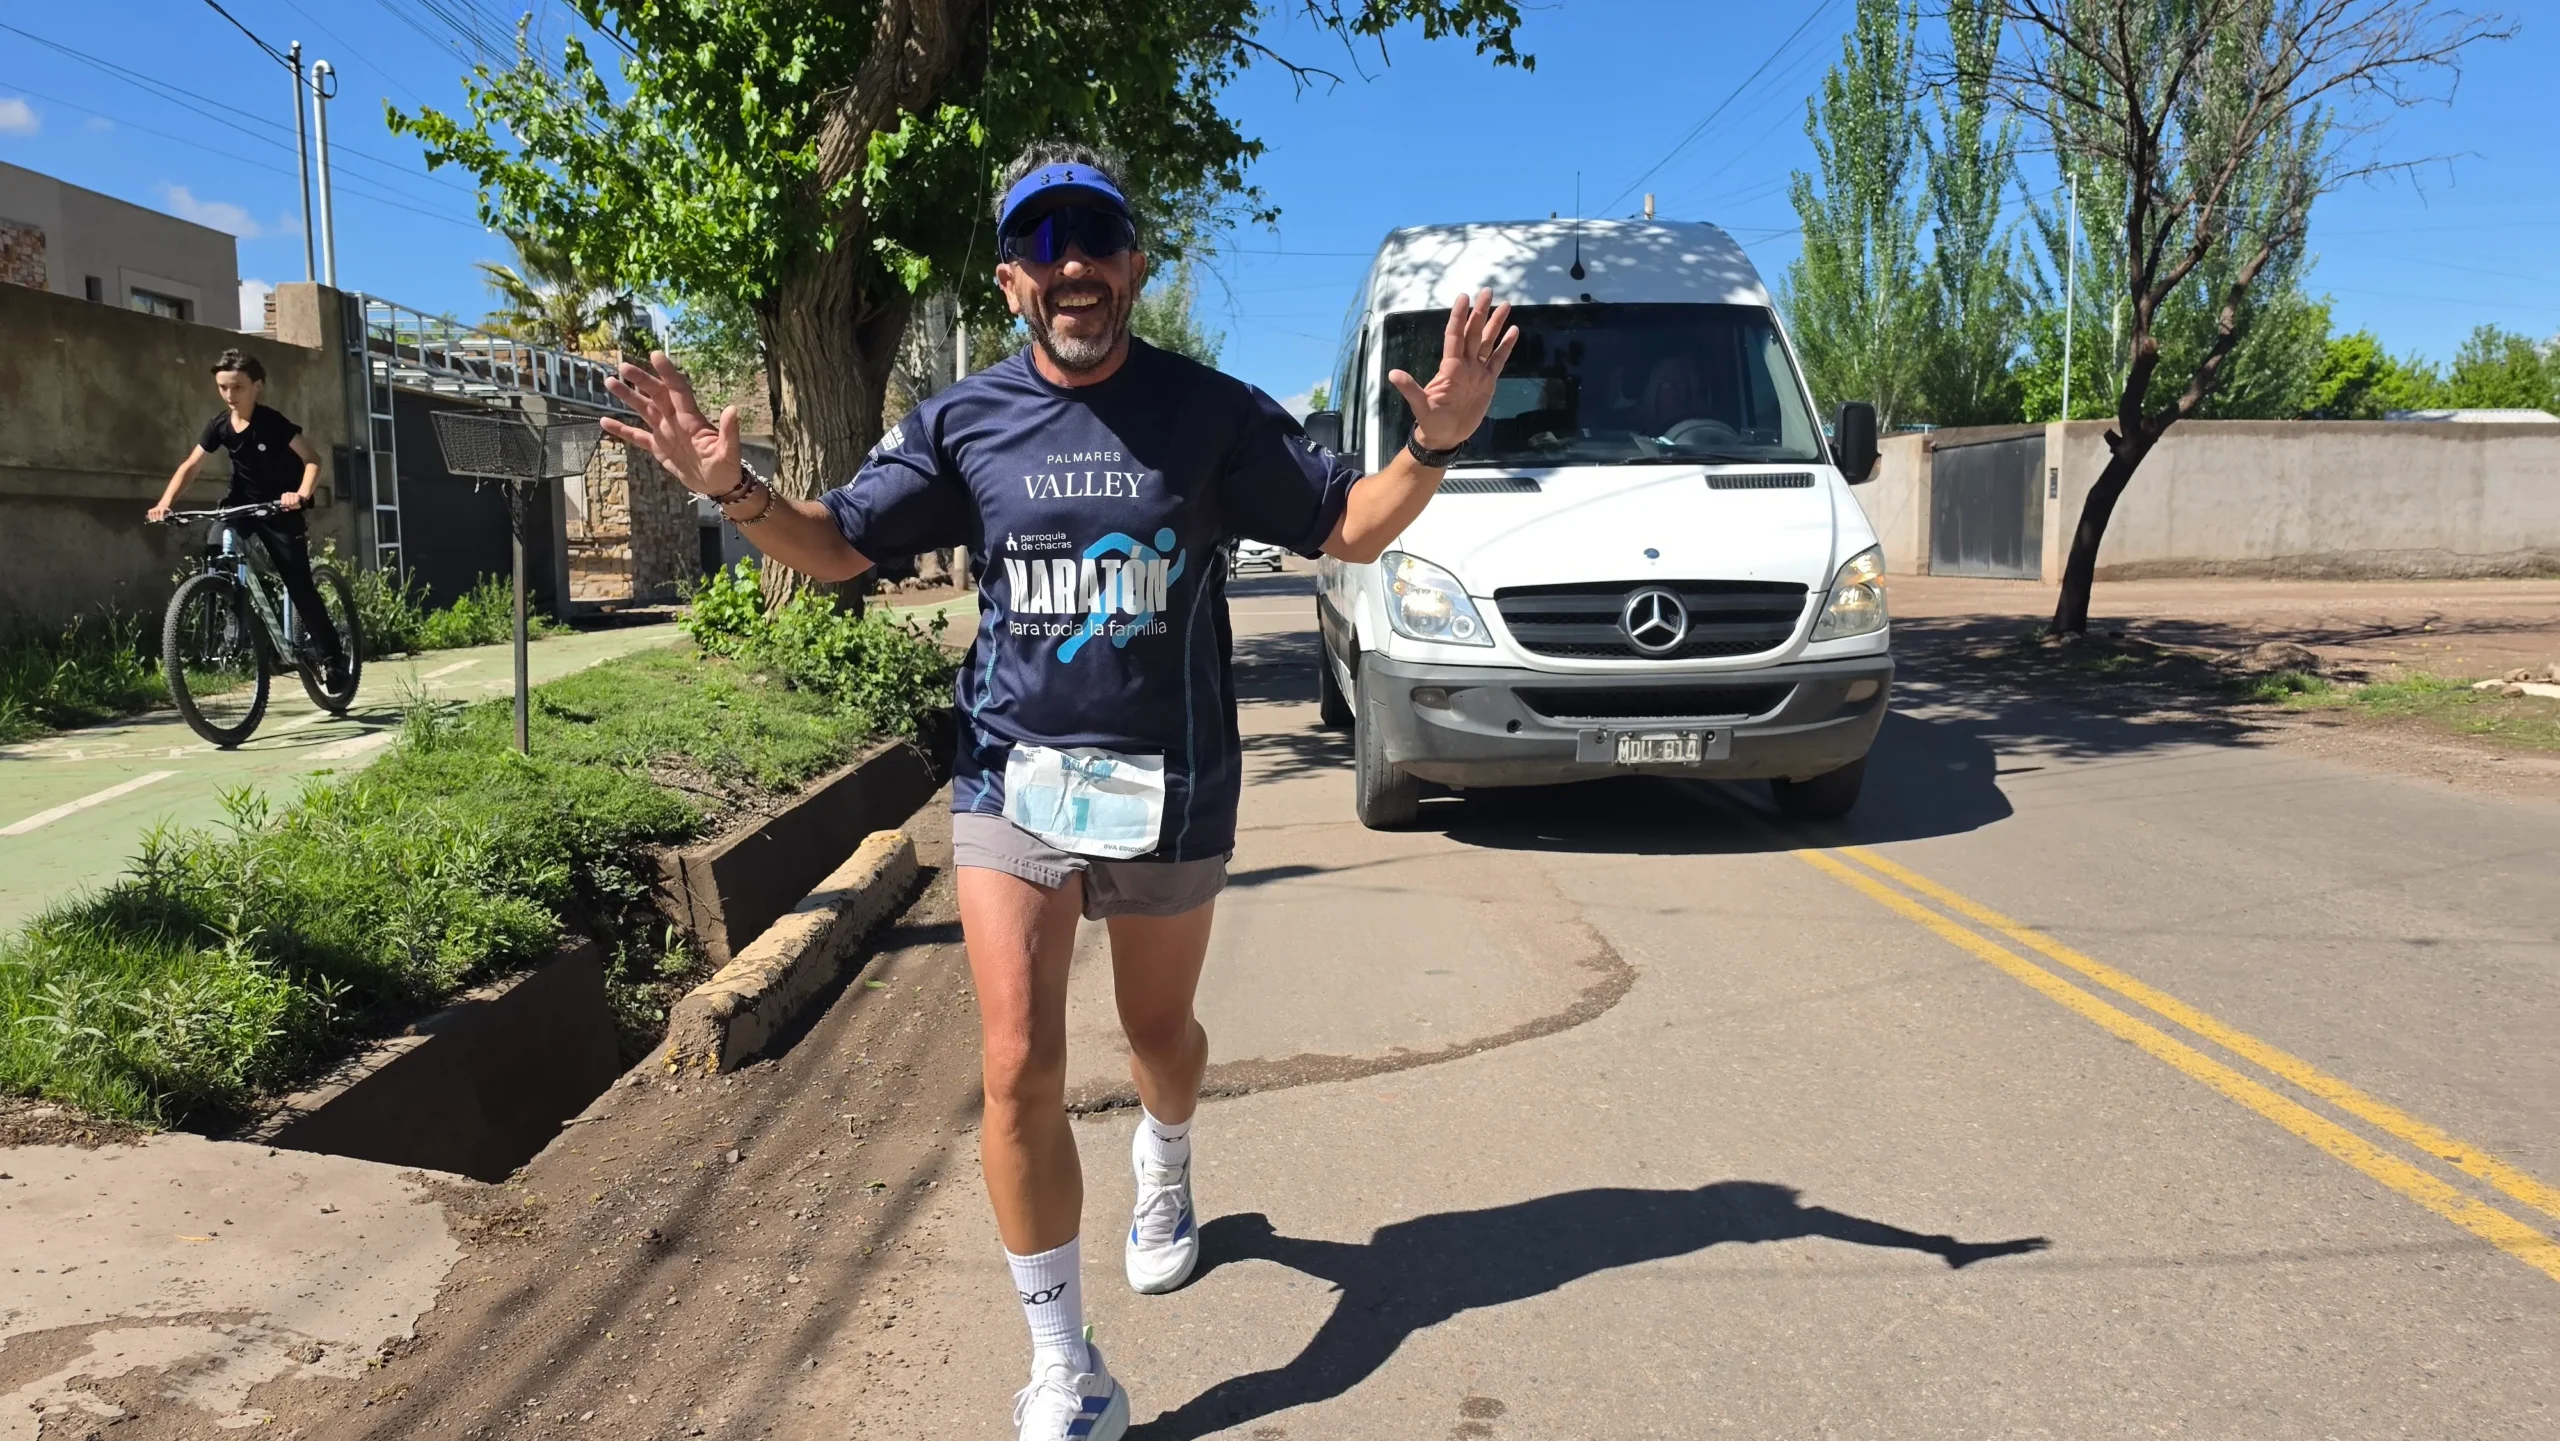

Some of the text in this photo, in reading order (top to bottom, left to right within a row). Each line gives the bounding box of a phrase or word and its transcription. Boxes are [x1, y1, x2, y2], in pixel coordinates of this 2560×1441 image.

[1047, 451, 1121, 465] PALMARES
[1023, 471, 1145, 499] VALLEY
[1020, 531, 1067, 543] parroquia
[1020, 539, 1072, 551] de chacras
[1003, 545, 1170, 616] MARATÓN
[1009, 618, 1167, 637] para toda la familia
